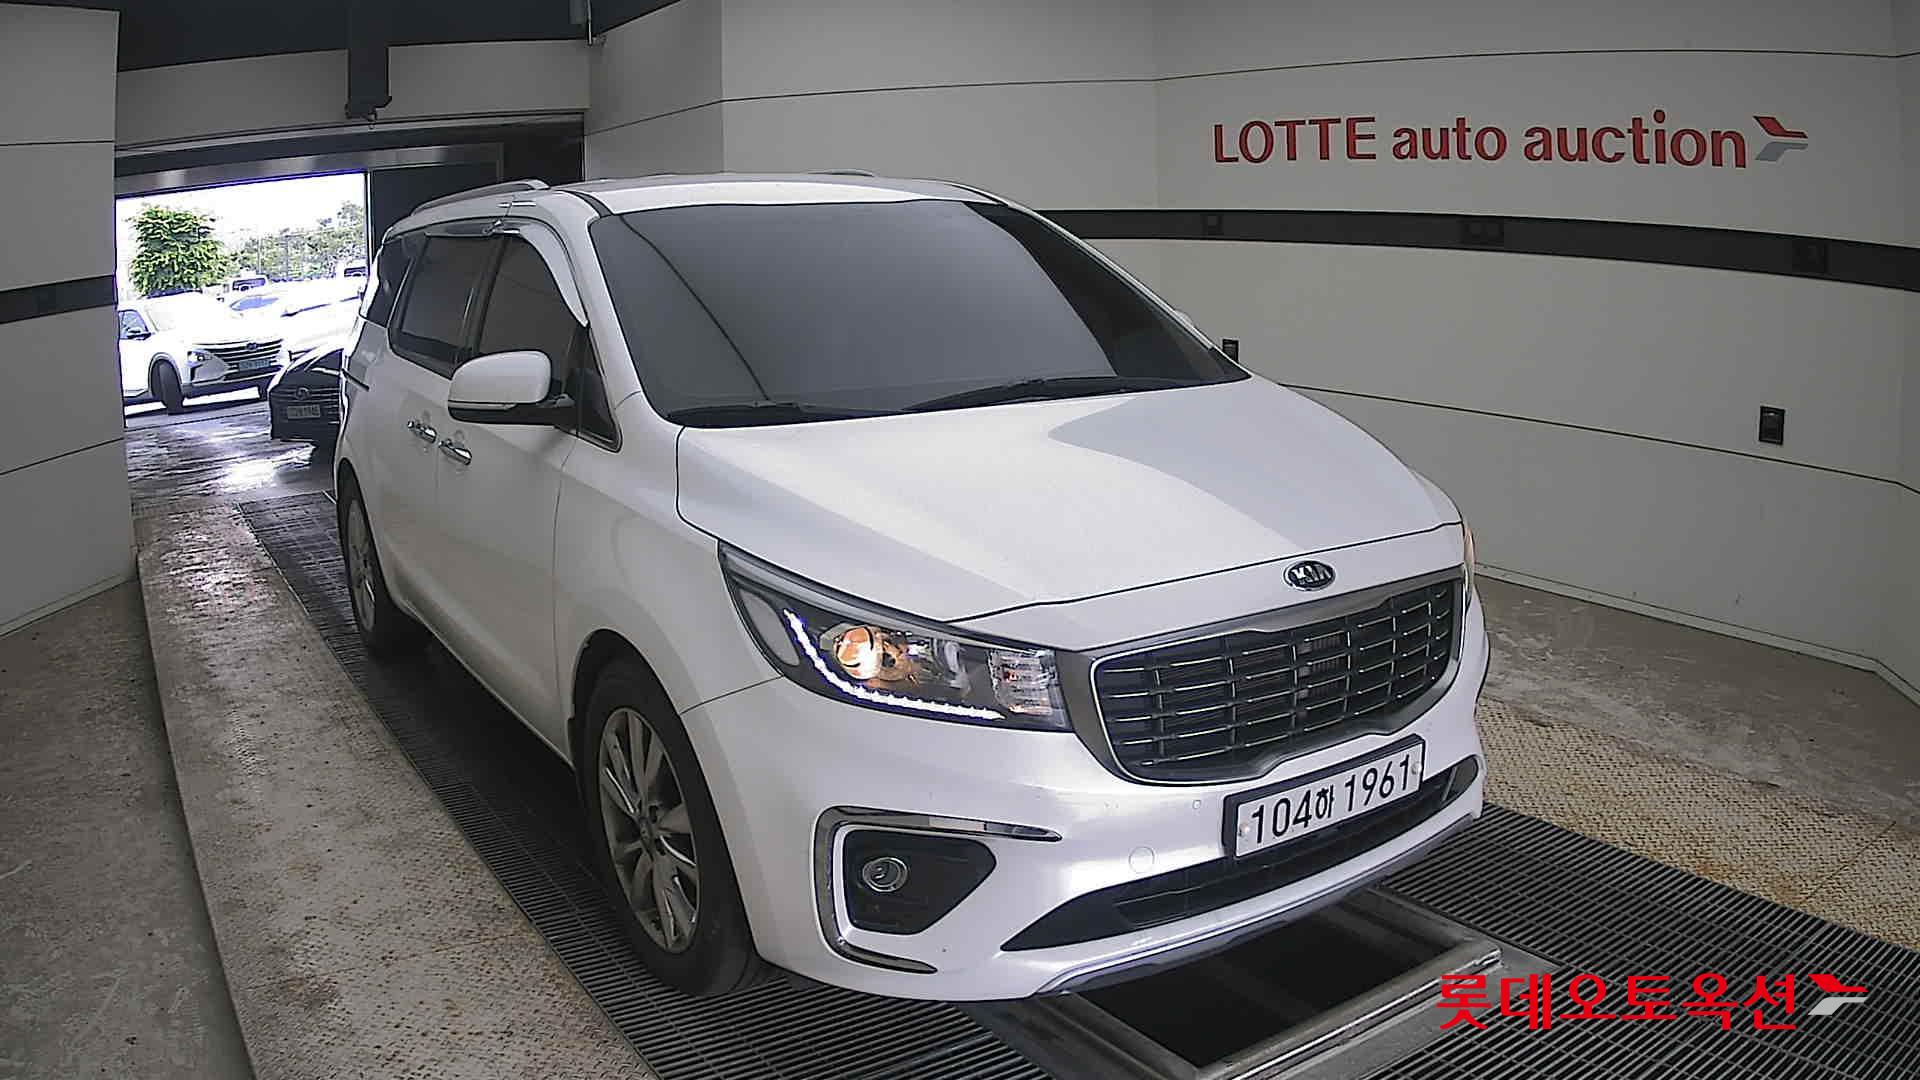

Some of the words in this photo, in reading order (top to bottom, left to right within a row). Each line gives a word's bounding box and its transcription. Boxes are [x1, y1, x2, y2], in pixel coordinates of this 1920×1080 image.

[1213, 115, 1377, 163] LOTTE
[1392, 116, 1508, 162] auto
[1523, 109, 1747, 168] auction
[1289, 564, 1332, 585] KIA
[1344, 754, 1411, 812] 1961
